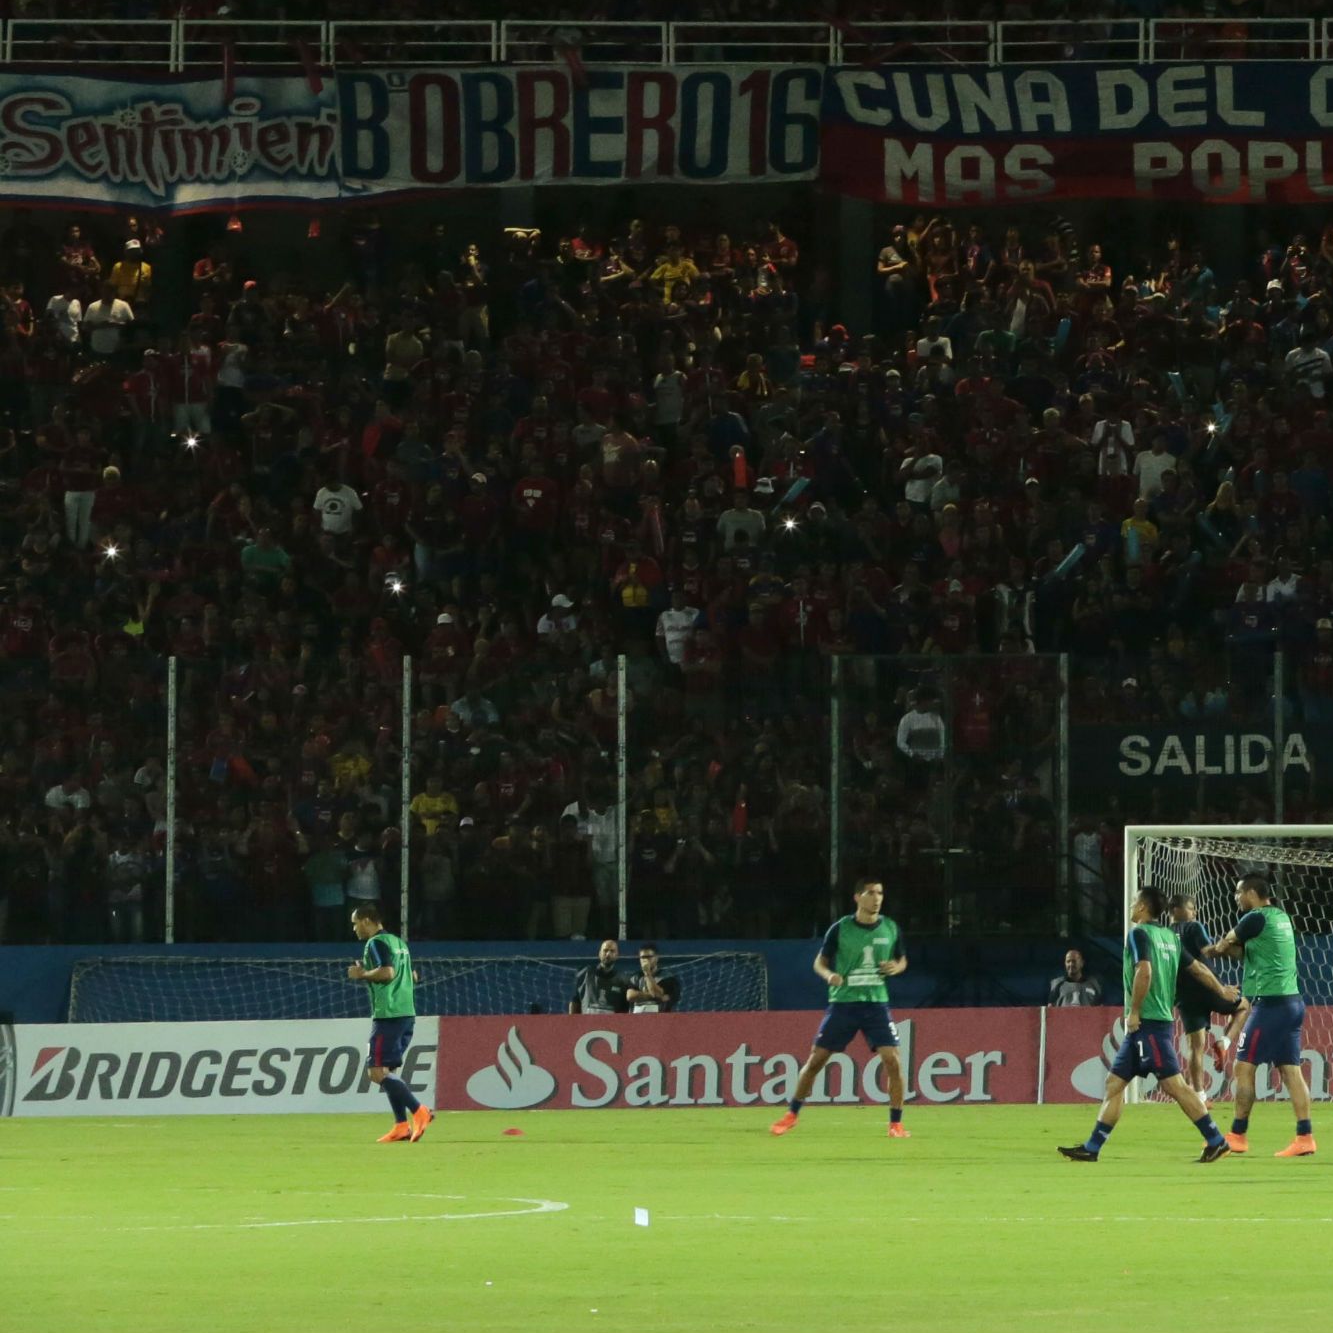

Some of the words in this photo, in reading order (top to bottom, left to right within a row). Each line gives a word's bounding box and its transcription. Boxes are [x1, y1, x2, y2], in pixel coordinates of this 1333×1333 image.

[833, 66, 1073, 133] CUNA
[1097, 65, 1266, 131] DEL
[0, 90, 338, 197] Sentimien
[883, 137, 1056, 203] MAS
[1118, 732, 1311, 777] SALIDA
[571, 1018, 1003, 1108] Santander
